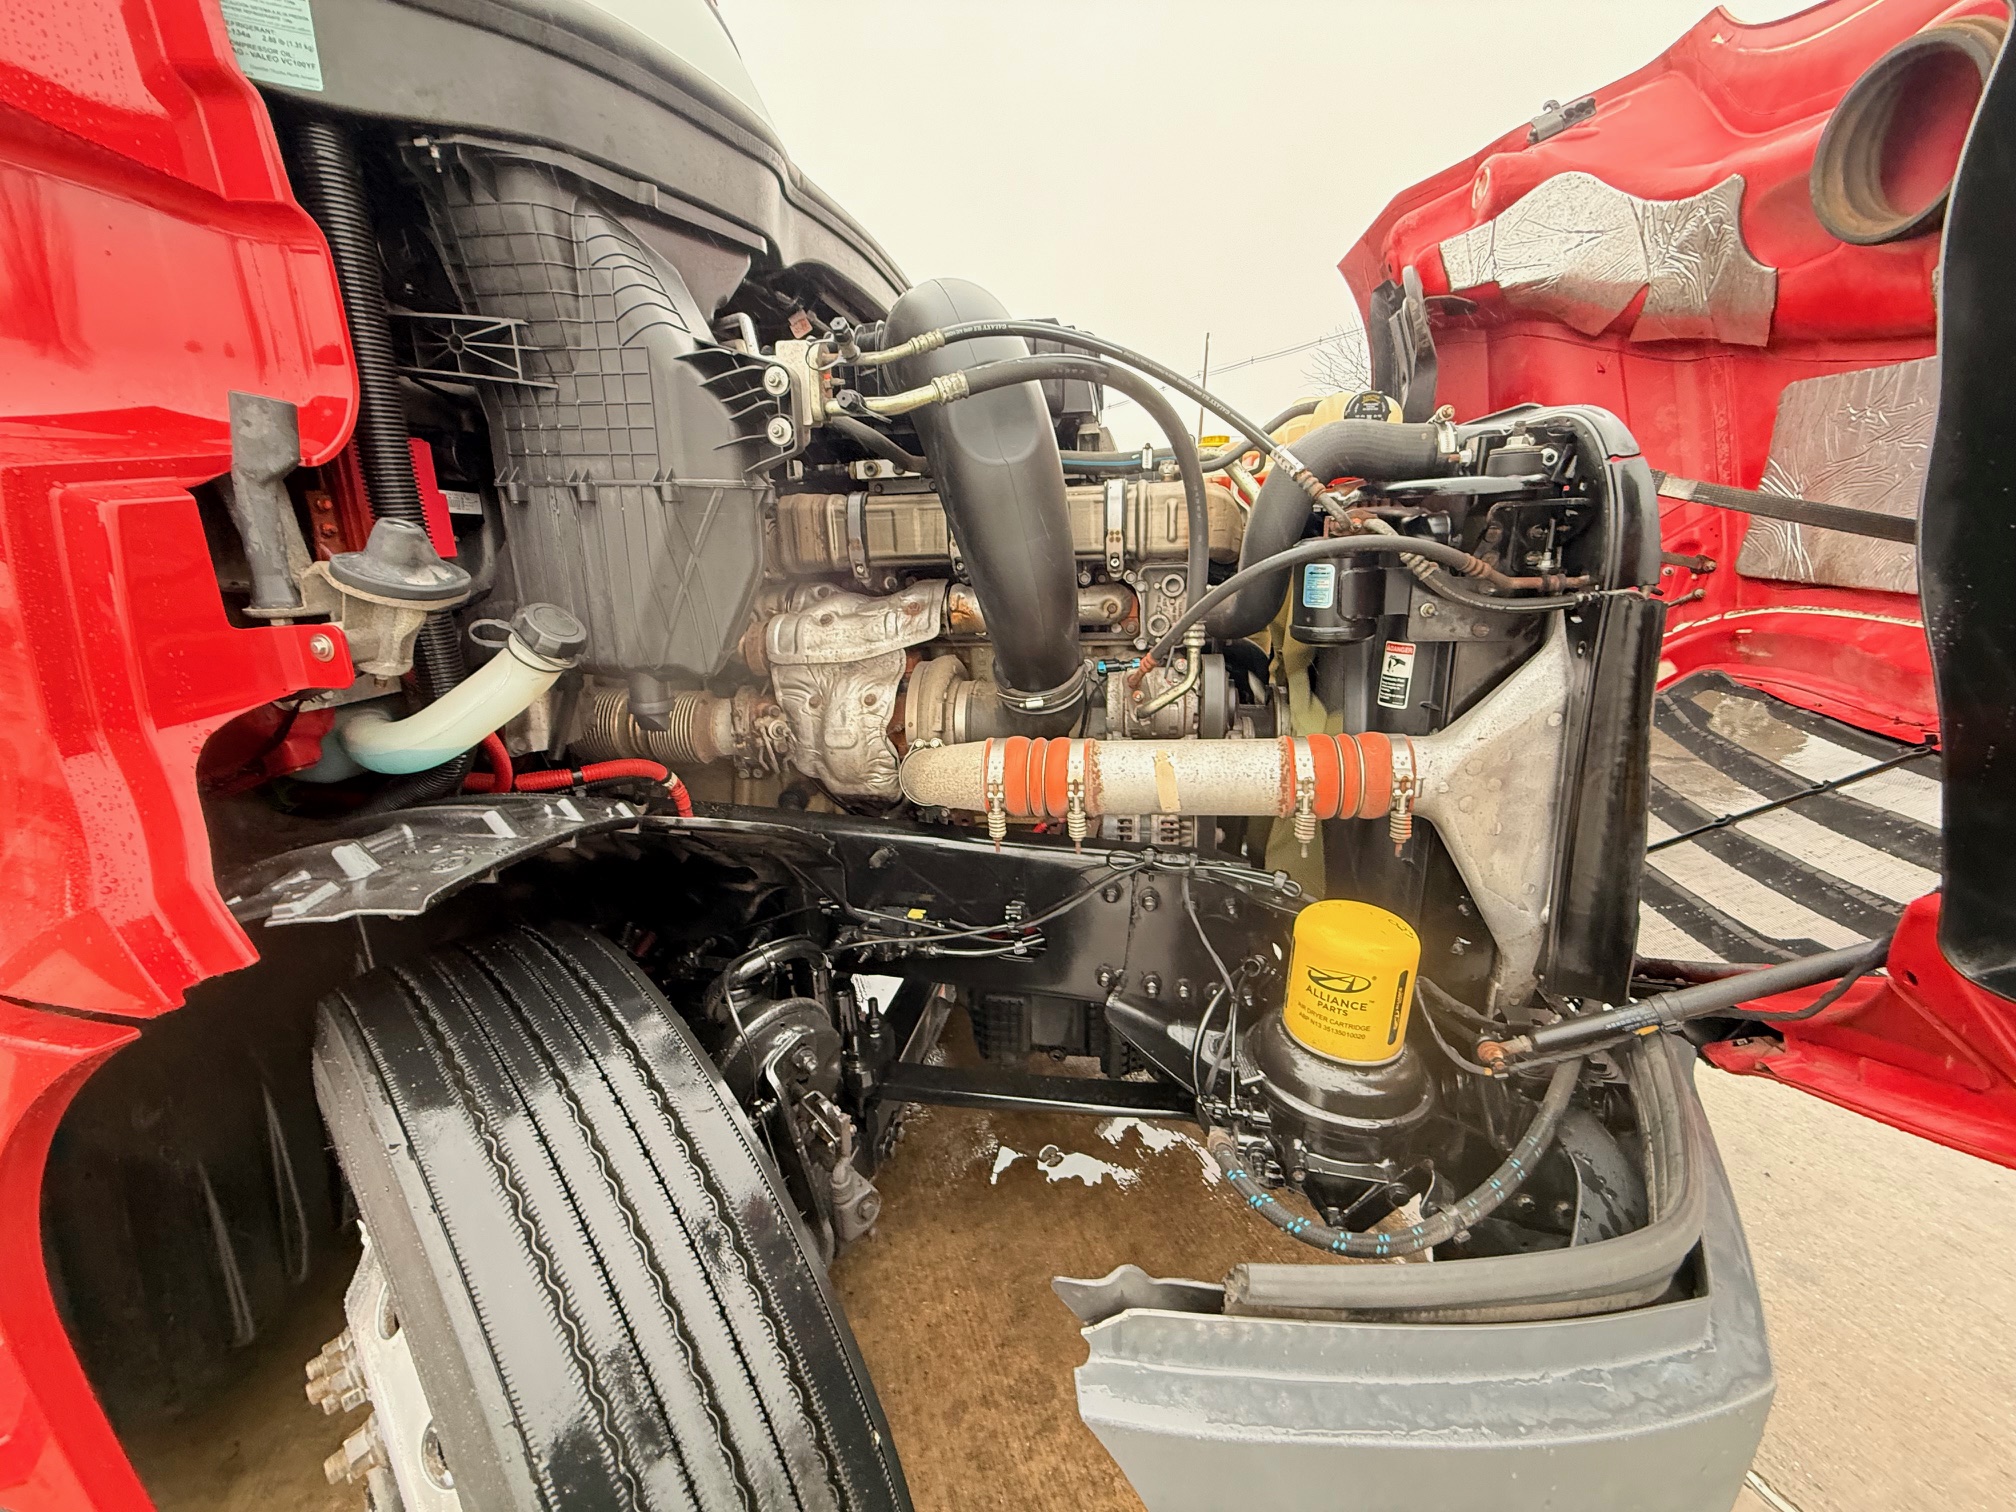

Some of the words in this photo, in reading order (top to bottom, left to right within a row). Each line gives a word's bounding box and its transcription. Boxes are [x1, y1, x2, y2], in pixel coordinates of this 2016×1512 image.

[250, 51, 279, 63] VALEO
[982, 323, 1007, 331] GALAXY
[1317, 1001, 1348, 1016] PARTS
[1298, 1002, 1306, 1011] AIR
[1307, 1008, 1328, 1022] DRYER
[1329, 1018, 1371, 1032] CARTRIDGE
[1299, 1012, 1310, 1021] ABP
